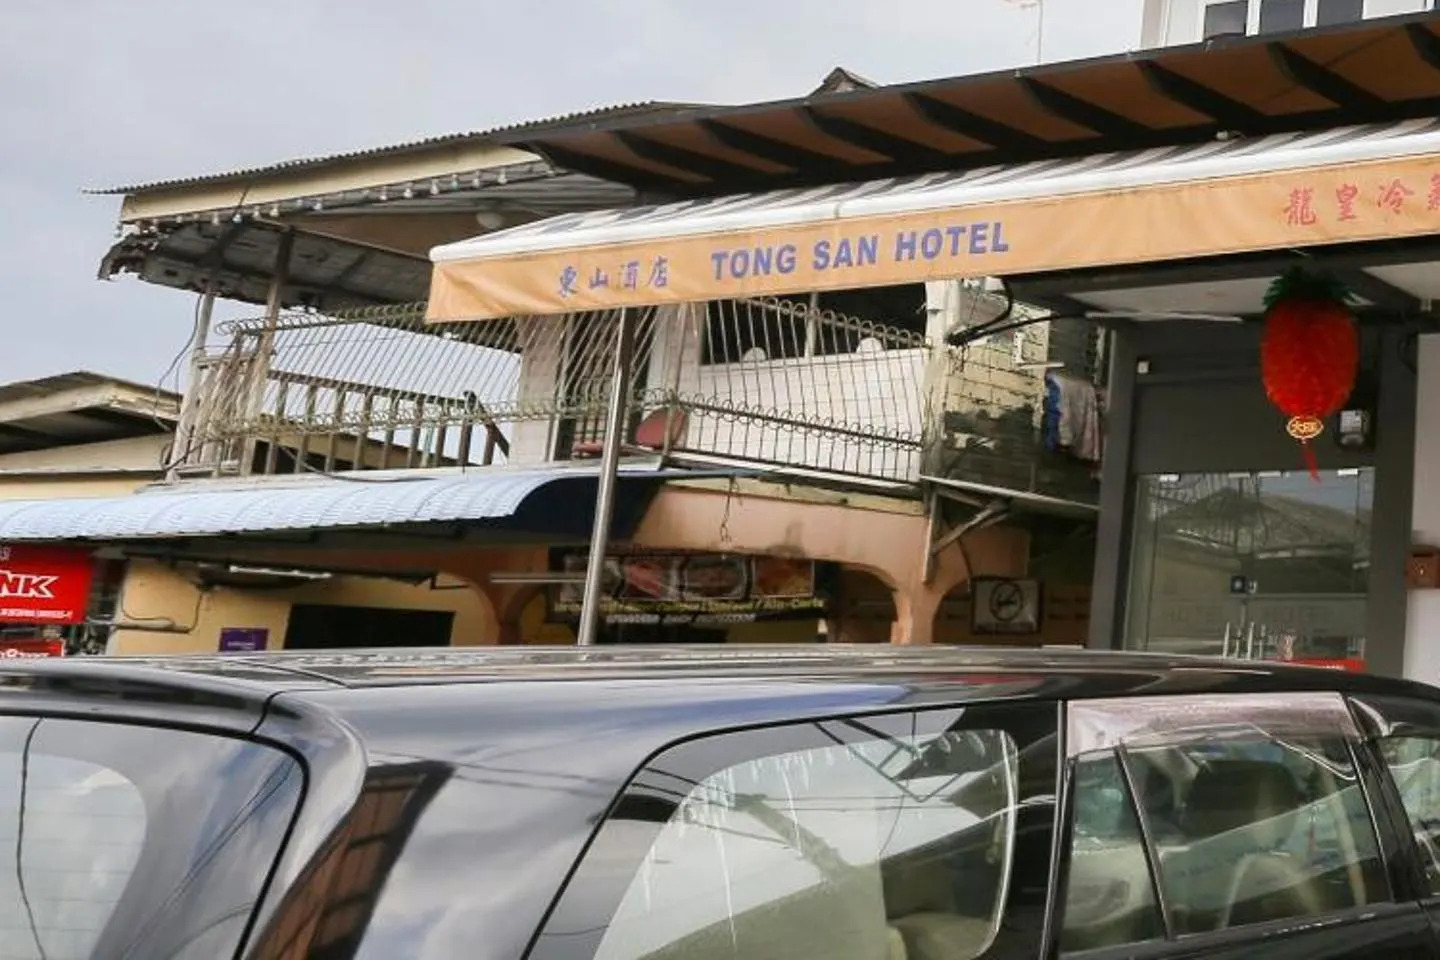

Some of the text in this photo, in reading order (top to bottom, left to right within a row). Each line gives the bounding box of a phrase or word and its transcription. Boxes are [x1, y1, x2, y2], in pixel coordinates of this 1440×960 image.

[558, 256, 669, 298] 東山酒店
[711, 221, 1010, 282] TONG SAN HOTEL
